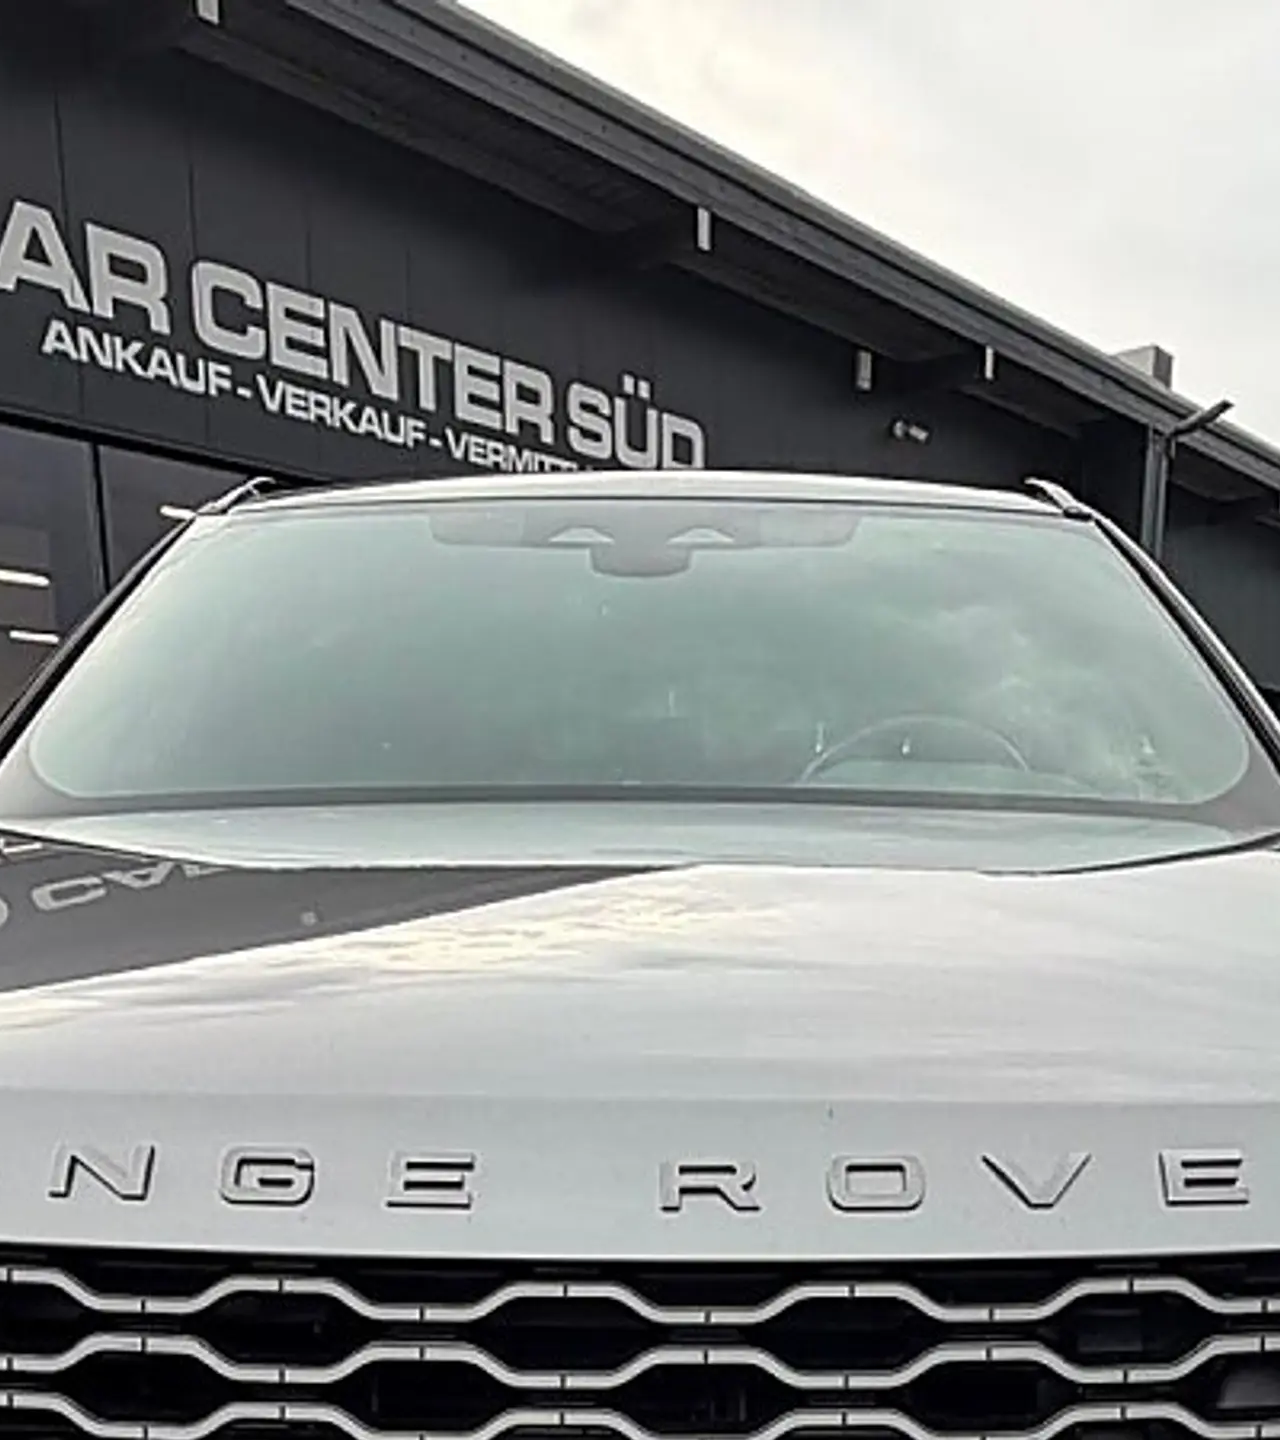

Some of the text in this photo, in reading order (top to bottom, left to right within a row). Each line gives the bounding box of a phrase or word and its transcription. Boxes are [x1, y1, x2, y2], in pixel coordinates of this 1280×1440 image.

[42, 319, 232, 396] ANKAUF
[256, 373, 426, 448] VERKAUF
[191, 260, 555, 445] CENTER
[566, 373, 706, 469] SÜD
